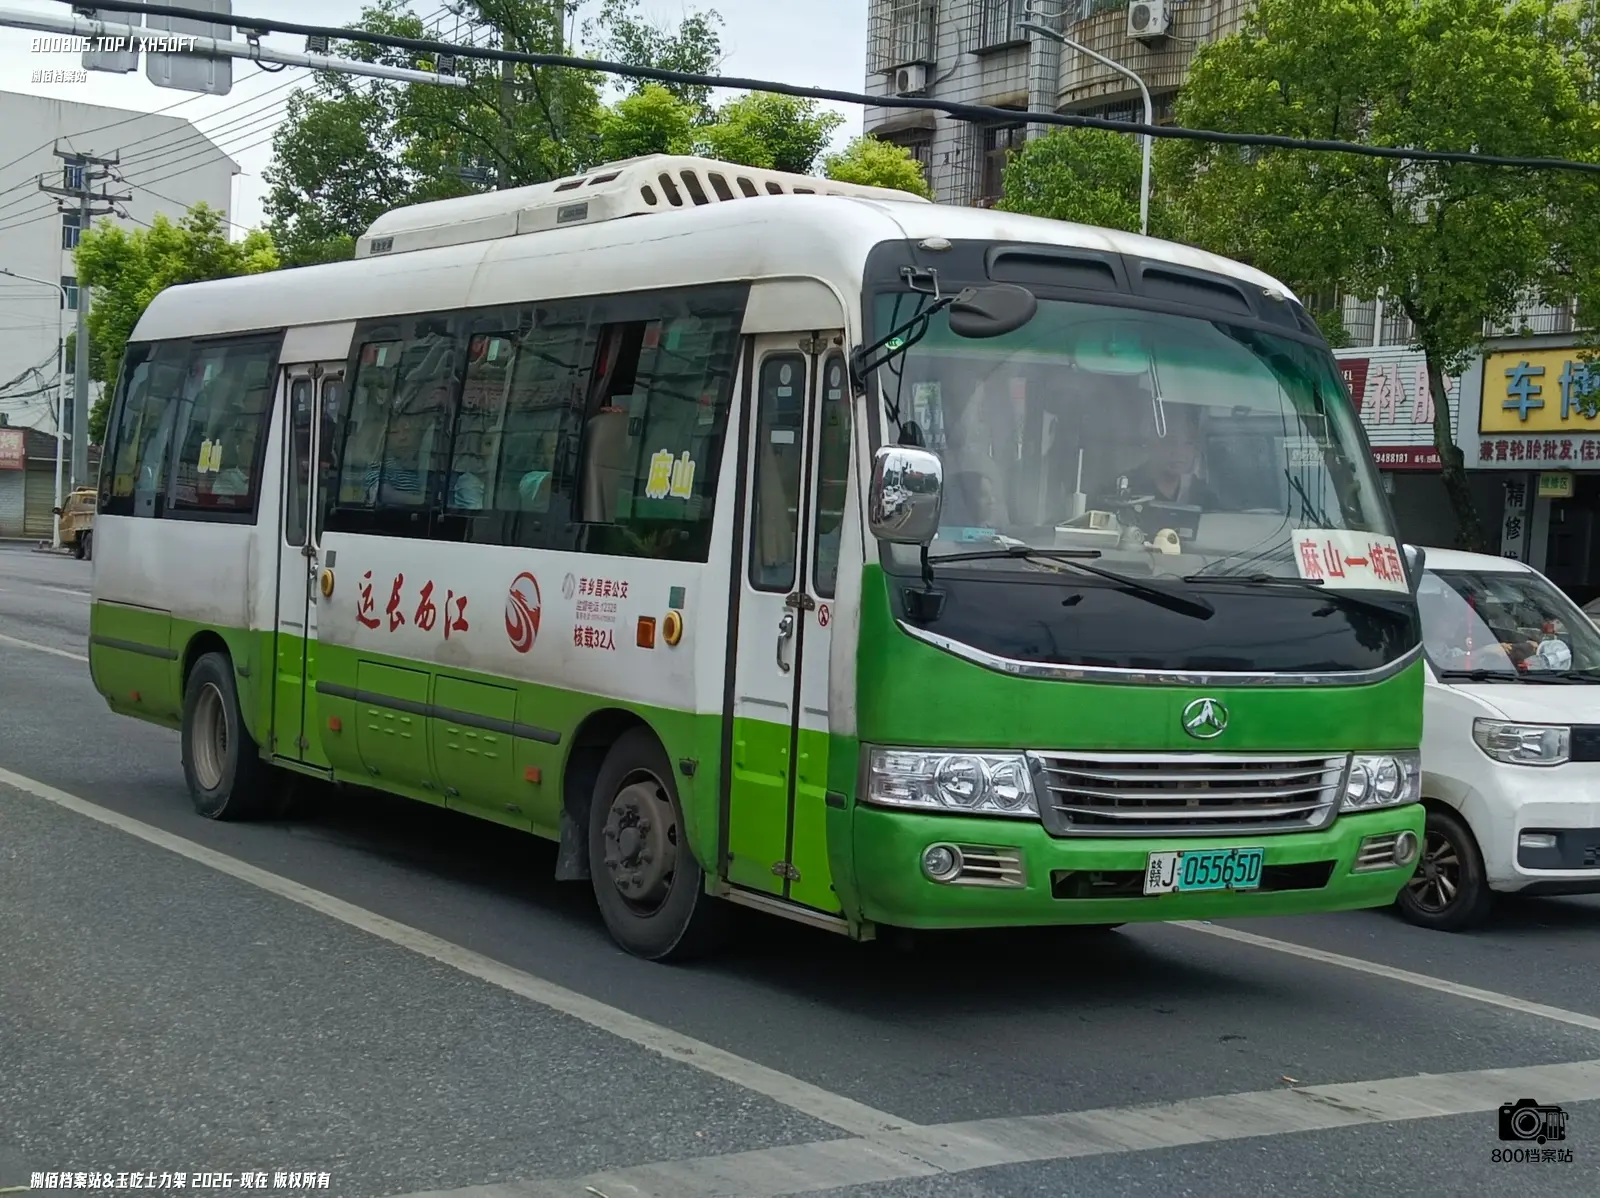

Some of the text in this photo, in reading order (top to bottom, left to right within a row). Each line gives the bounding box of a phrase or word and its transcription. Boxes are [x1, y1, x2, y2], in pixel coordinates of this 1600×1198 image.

[1373, 453, 1408, 463] 9488181
[578, 577, 629, 599] 萍乡昌荣公交
[573, 624, 616, 651] 核载32人
